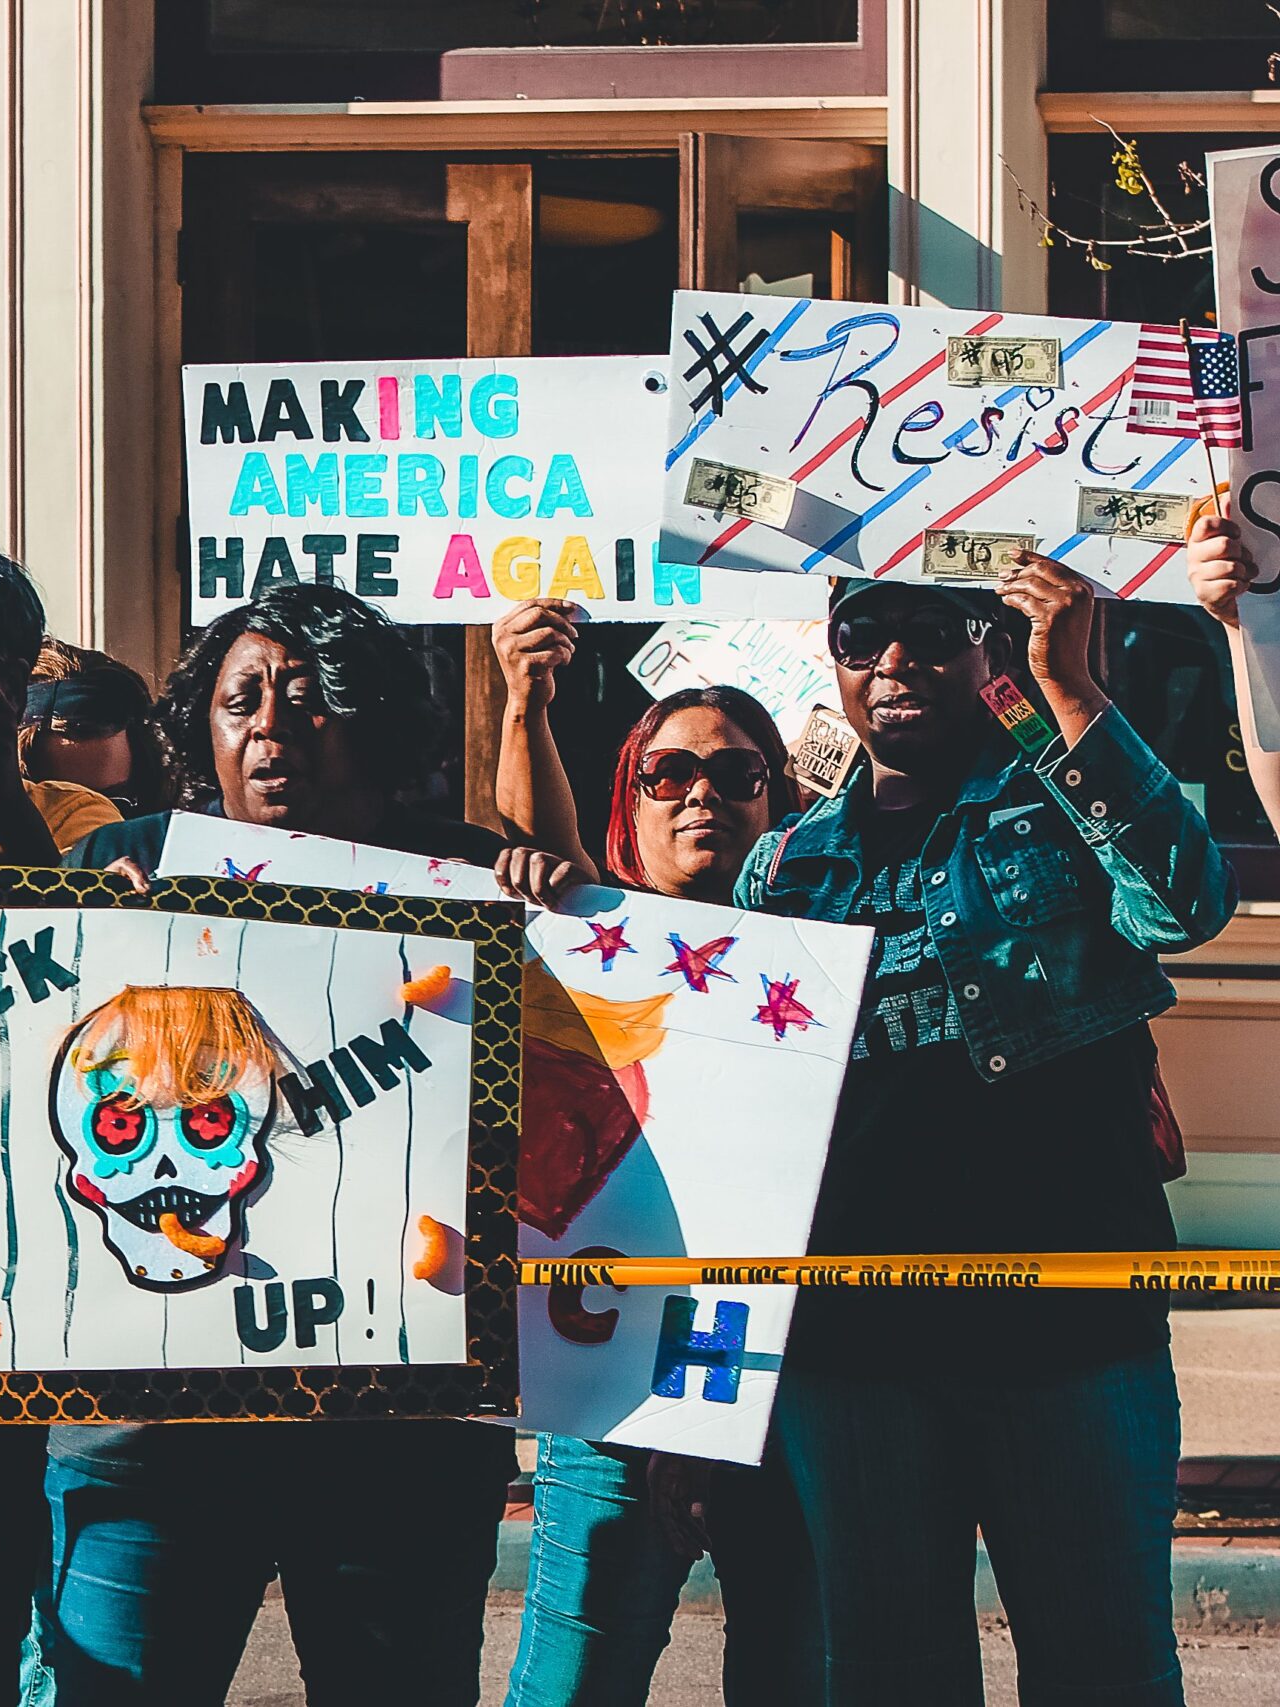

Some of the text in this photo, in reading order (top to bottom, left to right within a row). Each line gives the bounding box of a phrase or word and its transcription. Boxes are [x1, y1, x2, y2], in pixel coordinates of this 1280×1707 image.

[200, 374, 520, 445] MAKING
[229, 452, 594, 518] AMERICA
[198, 533, 703, 605] HATE AGAIN
[278, 1018, 432, 1138] HIM
